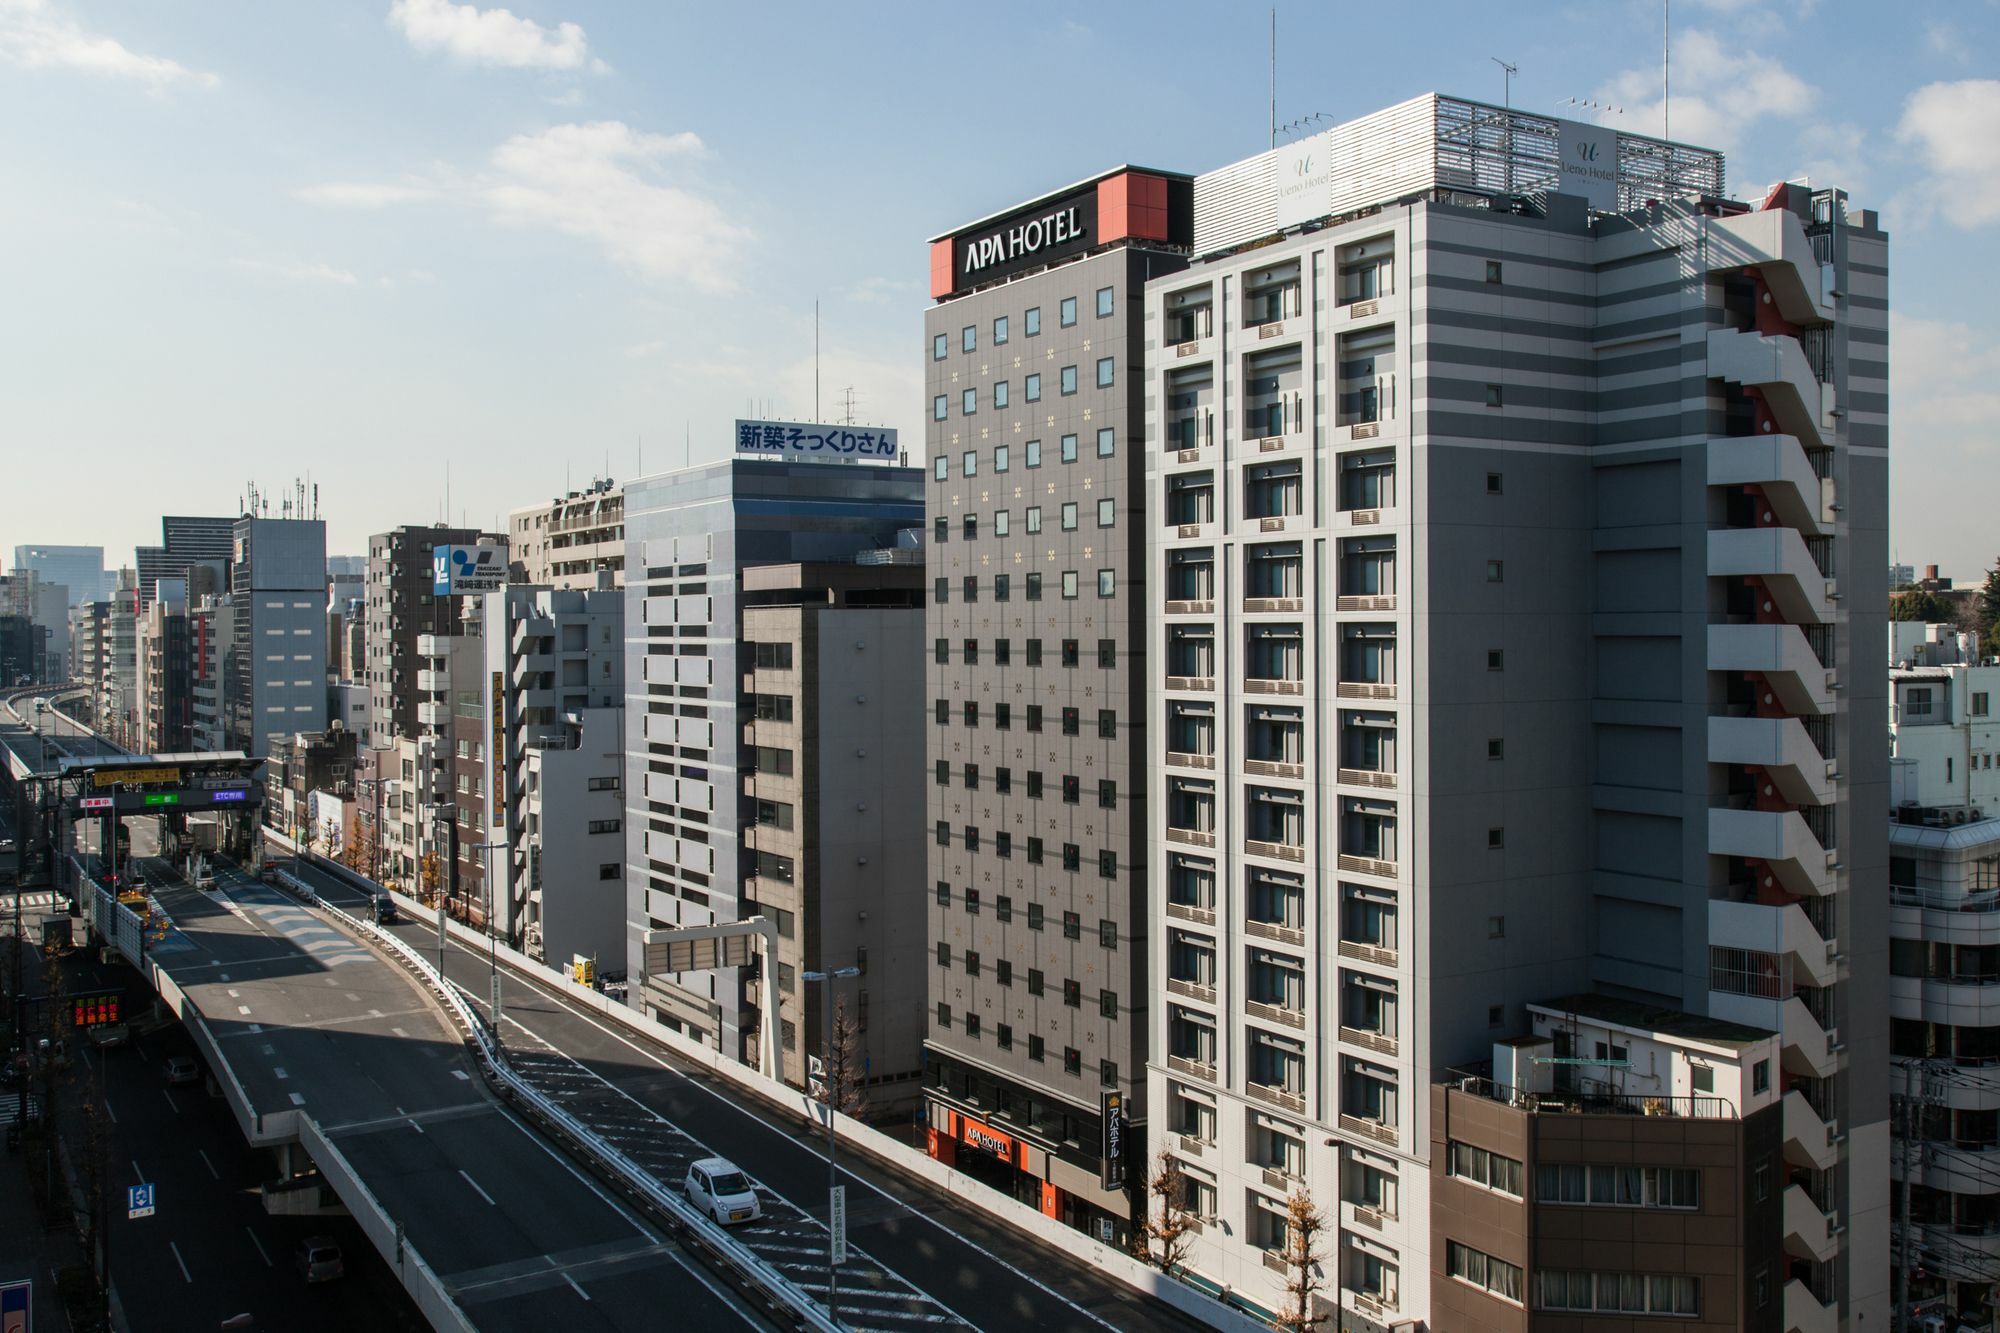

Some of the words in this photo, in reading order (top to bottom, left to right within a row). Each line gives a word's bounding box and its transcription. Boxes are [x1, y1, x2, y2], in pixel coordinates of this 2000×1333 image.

[1561, 161, 1587, 176] Ueno
[1589, 166, 1614, 181] Hotel
[1280, 182, 1303, 198] Ueno
[1304, 173, 1329, 190] Hotel
[965, 233, 1005, 273] APA
[1009, 207, 1081, 258] HOTEL
[740, 424, 895, 456] 新築そっくりさん
[967, 1127, 981, 1143] APA
[982, 1135, 1006, 1154] HOTEL
